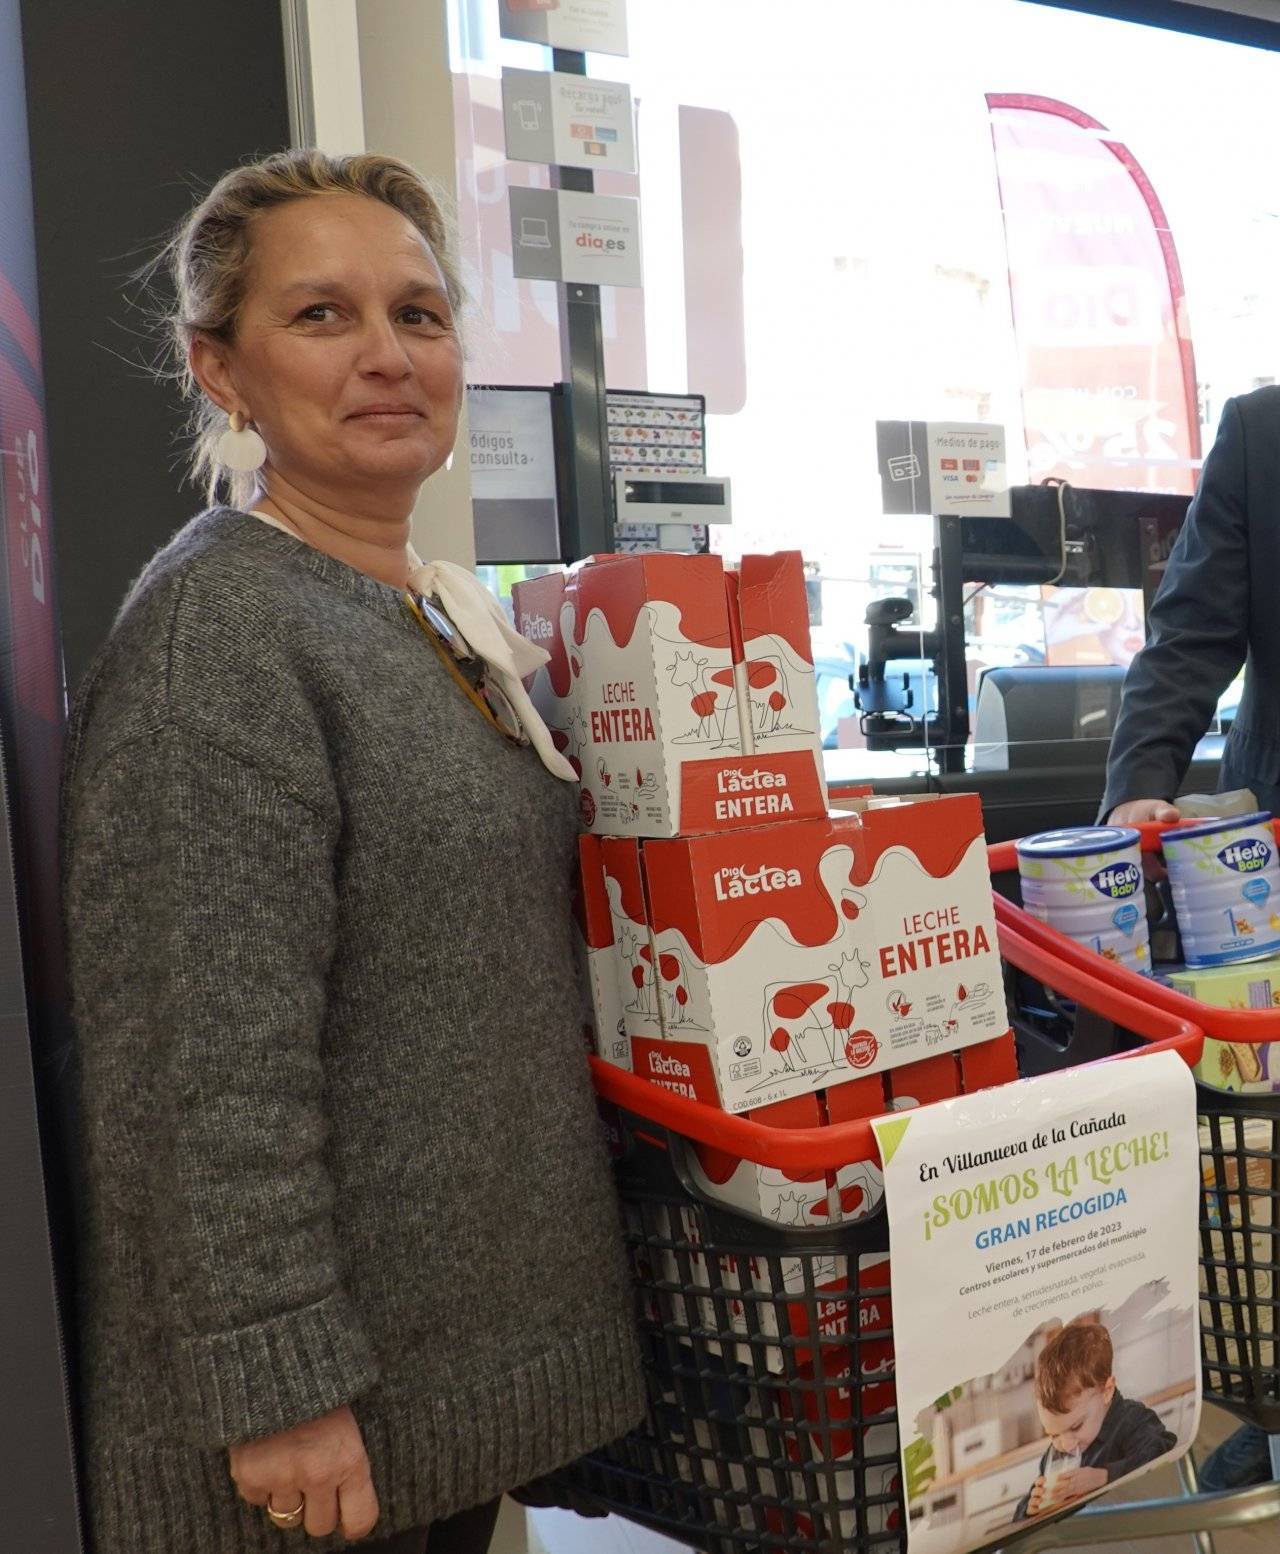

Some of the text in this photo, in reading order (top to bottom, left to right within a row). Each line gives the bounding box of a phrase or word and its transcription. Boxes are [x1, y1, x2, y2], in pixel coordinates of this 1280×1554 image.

[470, 451, 528, 465] consulta
[937, 437, 1000, 451] Medios de pago
[602, 681, 636, 704] LECHE
[591, 707, 656, 744] ENTERA
[715, 793, 794, 820] ENTERA
[1225, 841, 1268, 865] Hero
[1238, 858, 1265, 872] Baby
[1098, 864, 1139, 888] Hero
[1110, 882, 1136, 898] Baby
[903, 905, 962, 936] LECHE
[879, 924, 991, 979] ENTERA
[919, 1112, 1127, 1182] En Villanueva de la Cañada
[923, 1130, 1170, 1241] ¡SOMOS LA LECHE!
[975, 1187, 1128, 1250] GRAN RECOGIDA
[959, 1226, 1147, 1296] Centros escolares y supermercados del municipio
[985, 1221, 1122, 1273] Viernes, 17 de febrero de 2023
[968, 1305, 992, 1320] Leche
[1012, 1307, 1023, 1318] de
[1071, 1288, 1081, 1297] en
